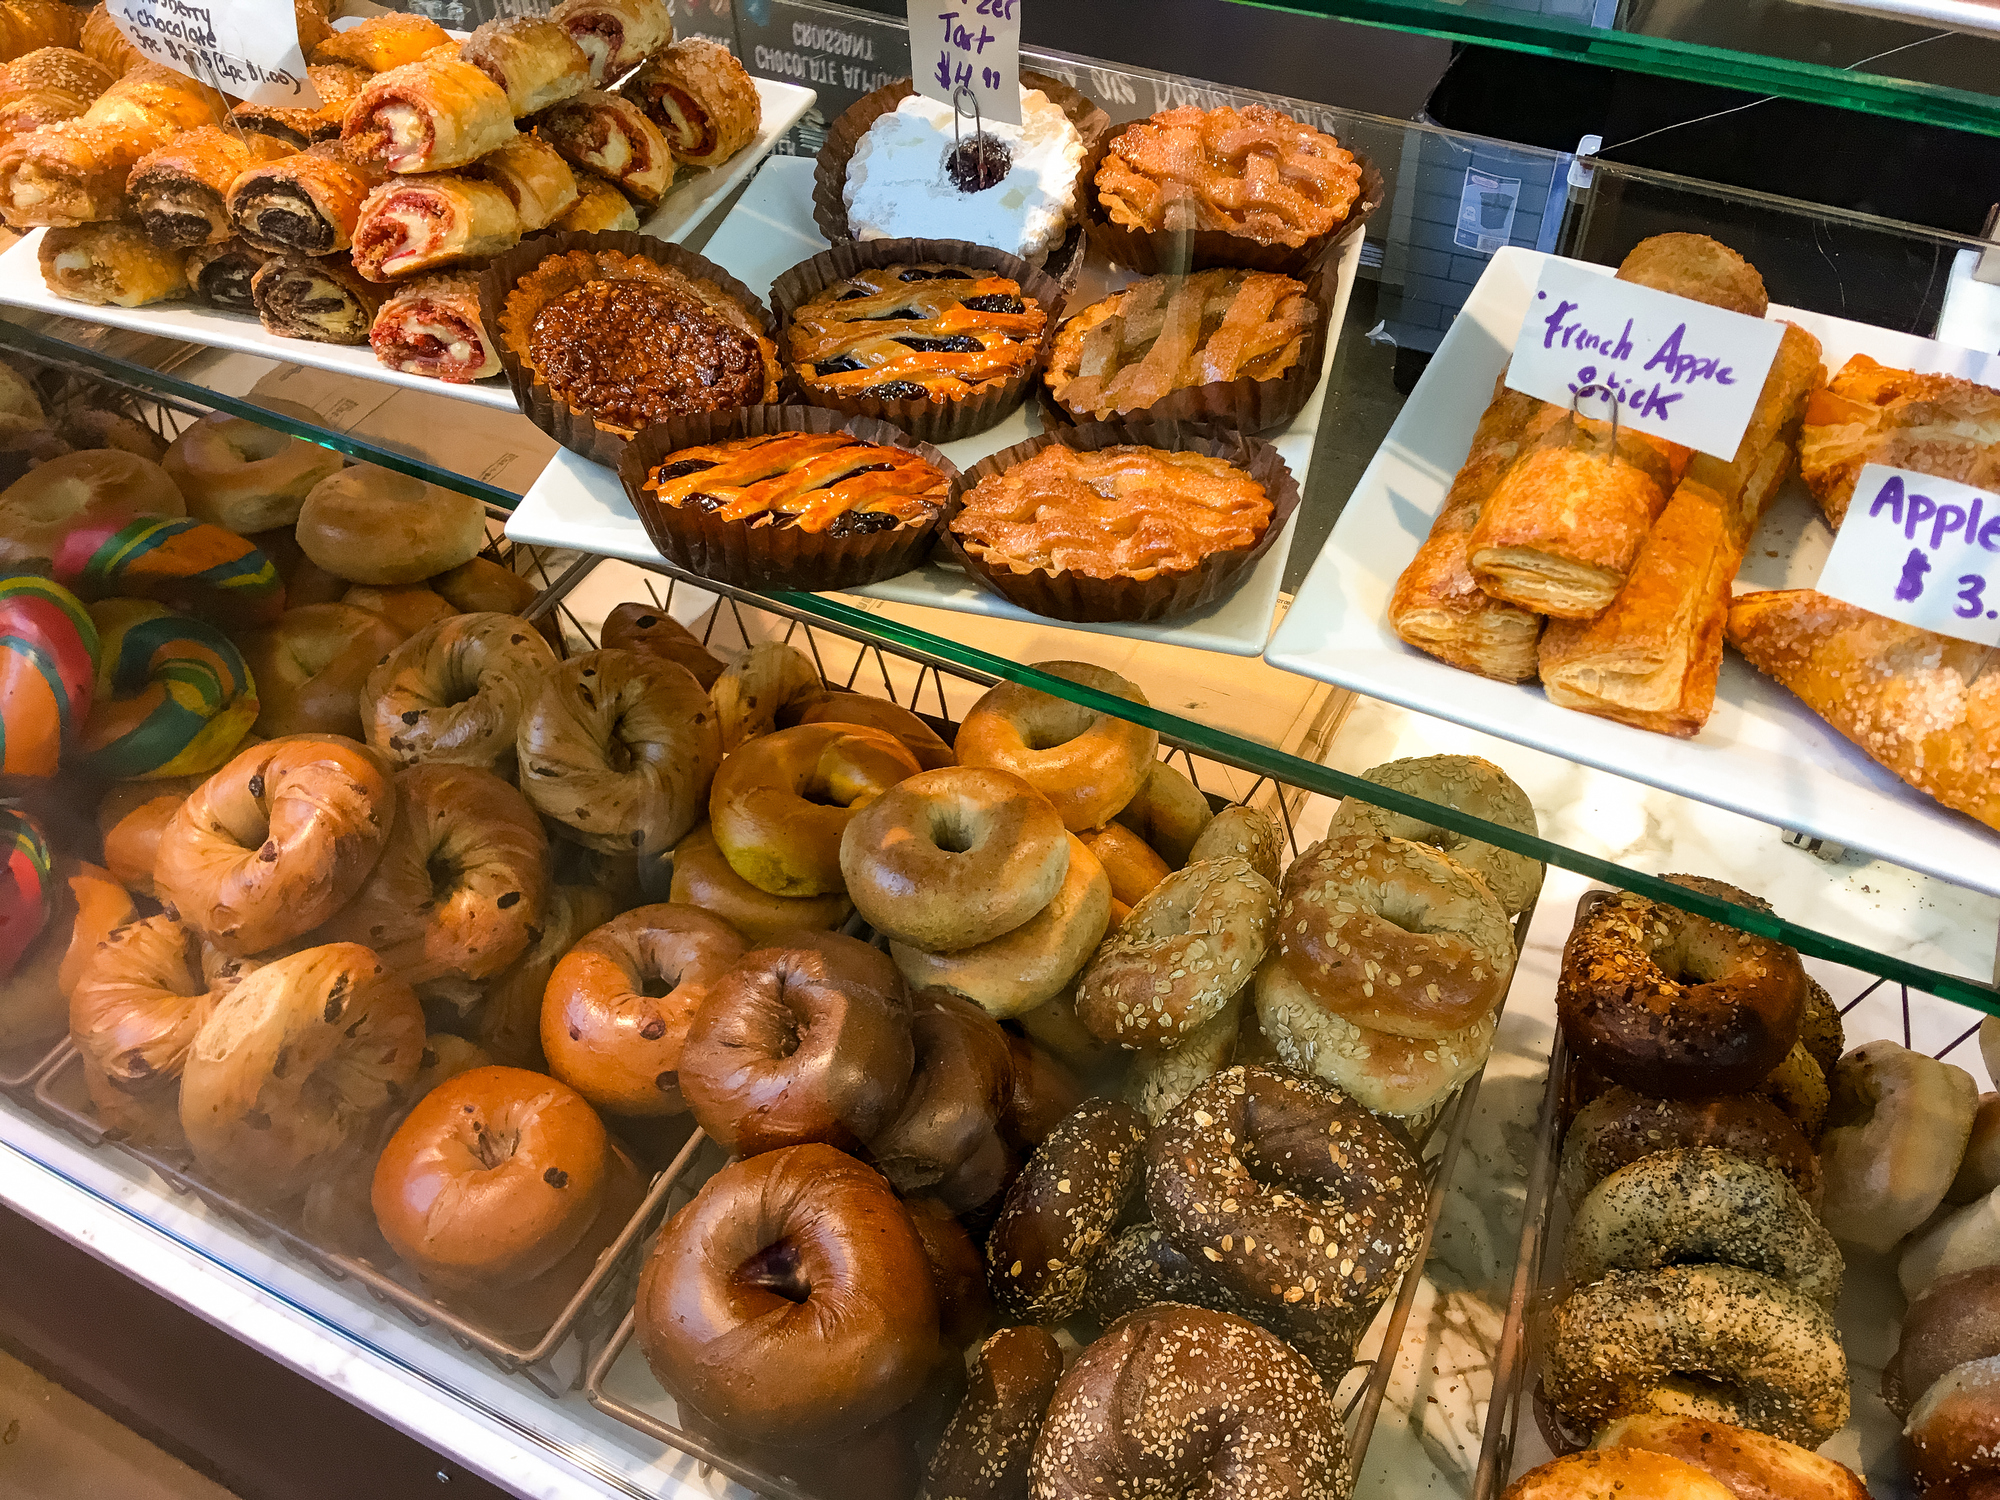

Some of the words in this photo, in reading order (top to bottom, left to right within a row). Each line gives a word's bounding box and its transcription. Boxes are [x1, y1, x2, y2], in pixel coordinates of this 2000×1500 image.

[938, 11, 995, 54] Tart
[1544, 300, 1634, 361] French
[1643, 323, 1738, 385] Apple
